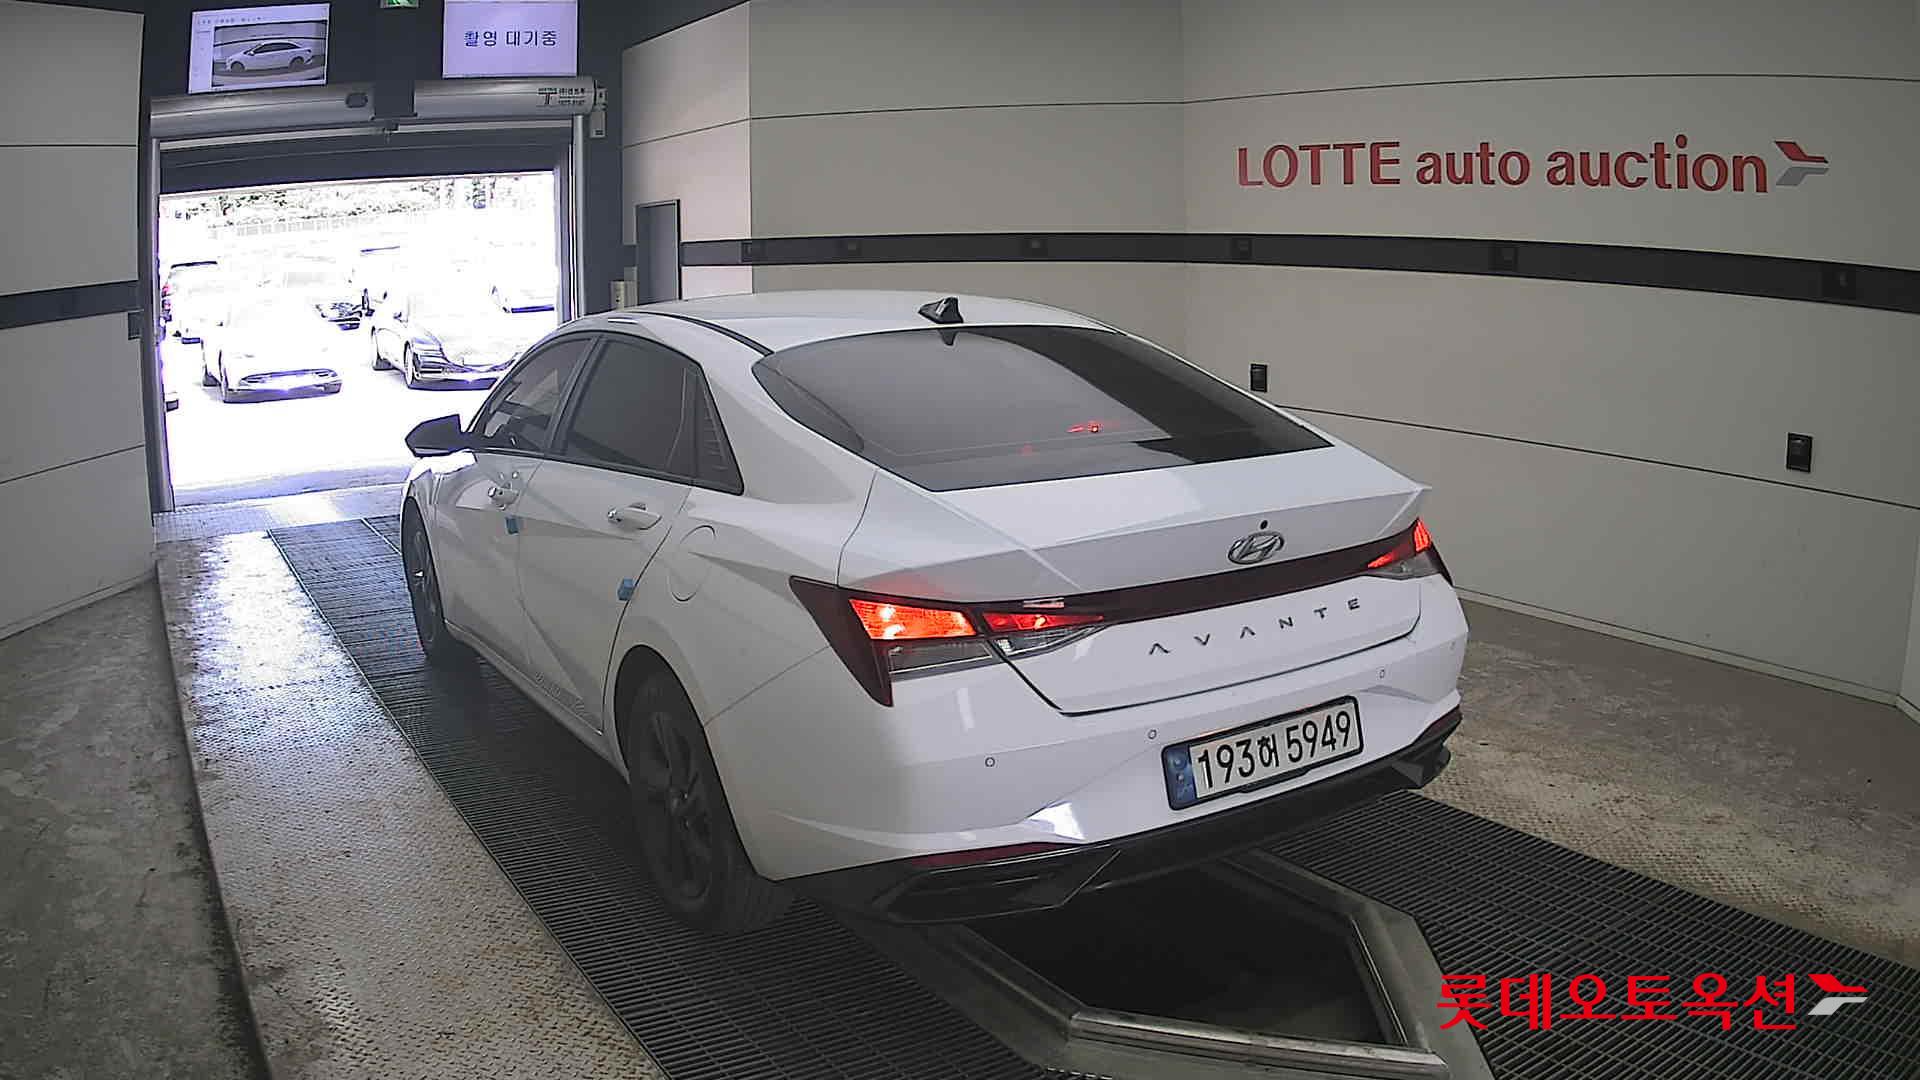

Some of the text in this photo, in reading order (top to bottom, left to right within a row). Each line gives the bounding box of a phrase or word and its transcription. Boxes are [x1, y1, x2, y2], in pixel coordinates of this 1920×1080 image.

[505, 30, 558, 47] 대기중
[1237, 134, 1769, 193] LOTTE auto auction
[1149, 598, 1361, 655] AVANTE
